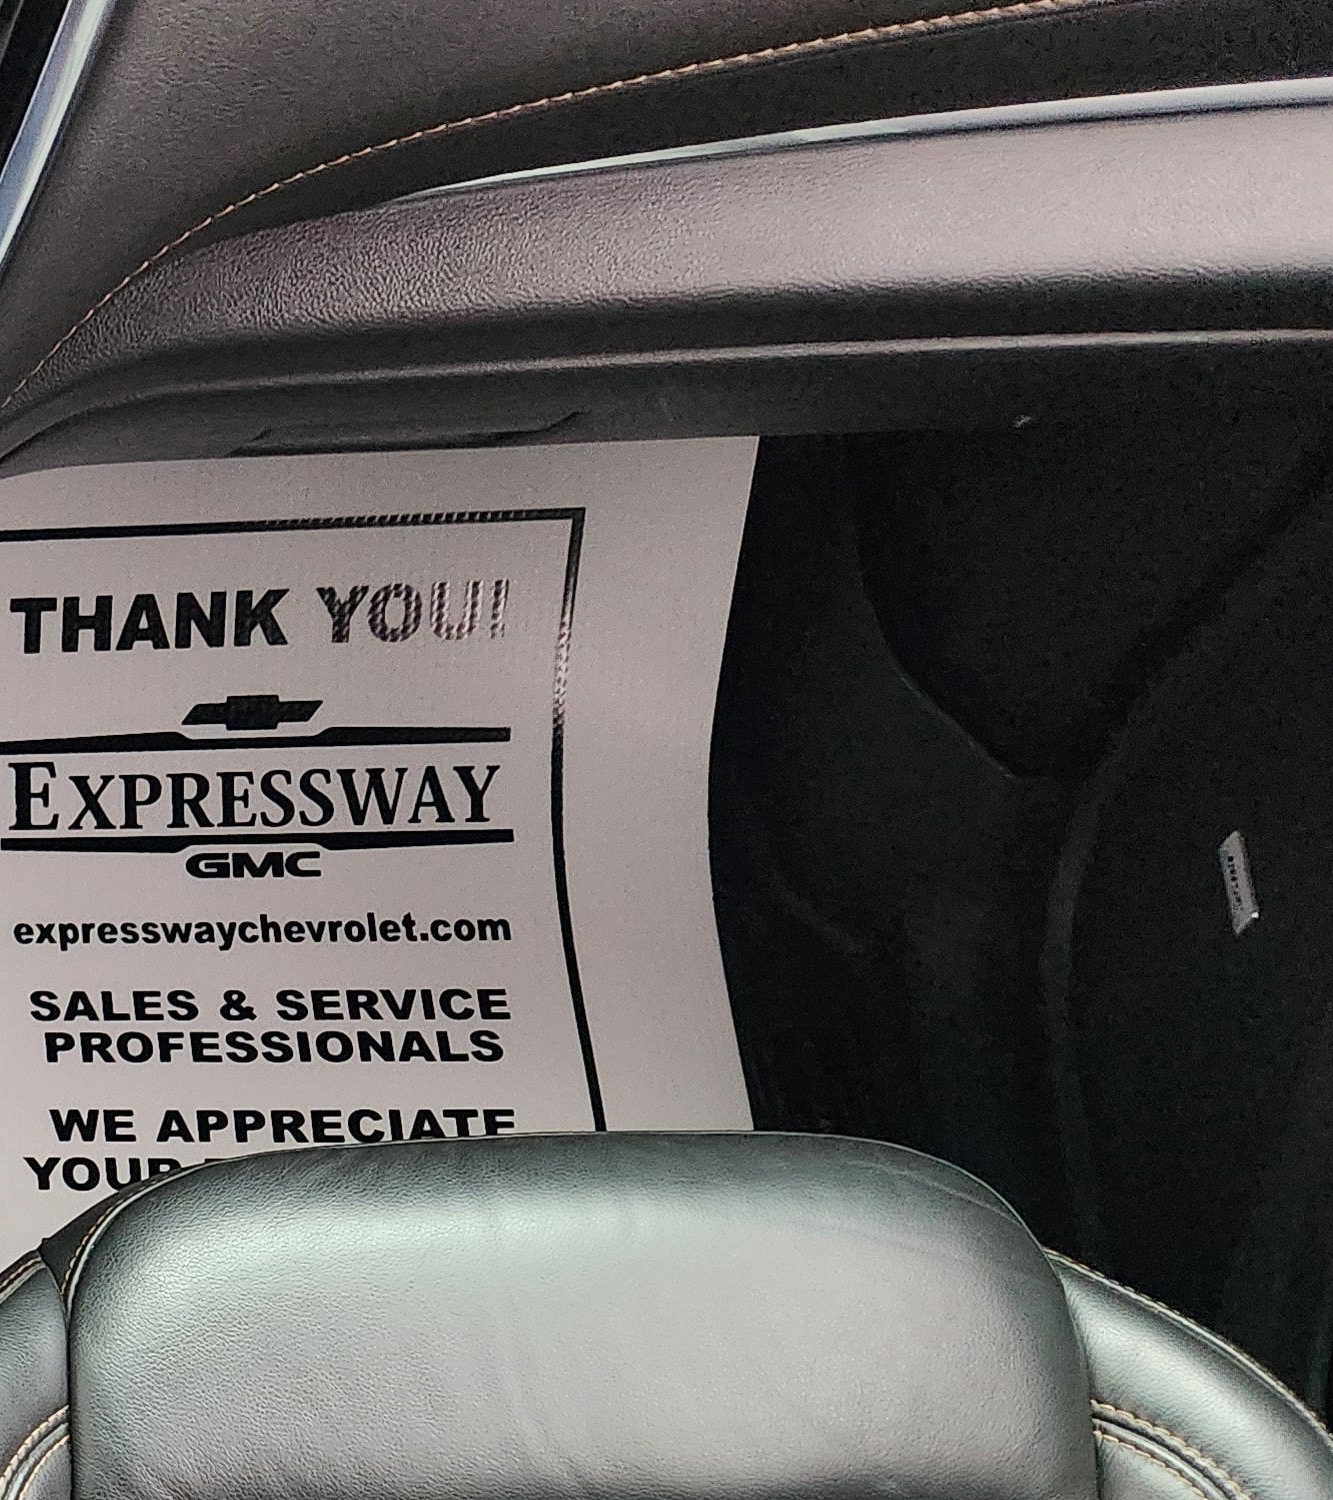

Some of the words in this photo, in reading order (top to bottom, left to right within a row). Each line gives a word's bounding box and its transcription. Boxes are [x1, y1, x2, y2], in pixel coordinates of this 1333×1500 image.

[10, 588, 291, 654] THANK
[316, 579, 510, 643] YOU!
[8, 762, 501, 831] EXPRESSWAY
[186, 851, 322, 878] GMC
[13, 912, 512, 951] expresswaychevrolet.com
[30, 990, 199, 1021] SALES
[220, 990, 257, 1021] &
[276, 988, 511, 1021] SERVICE
[45, 1030, 504, 1063] PROFESSIONALS
[49, 1109, 137, 1142] WE
[156, 1109, 515, 1142] APPRECIATE
